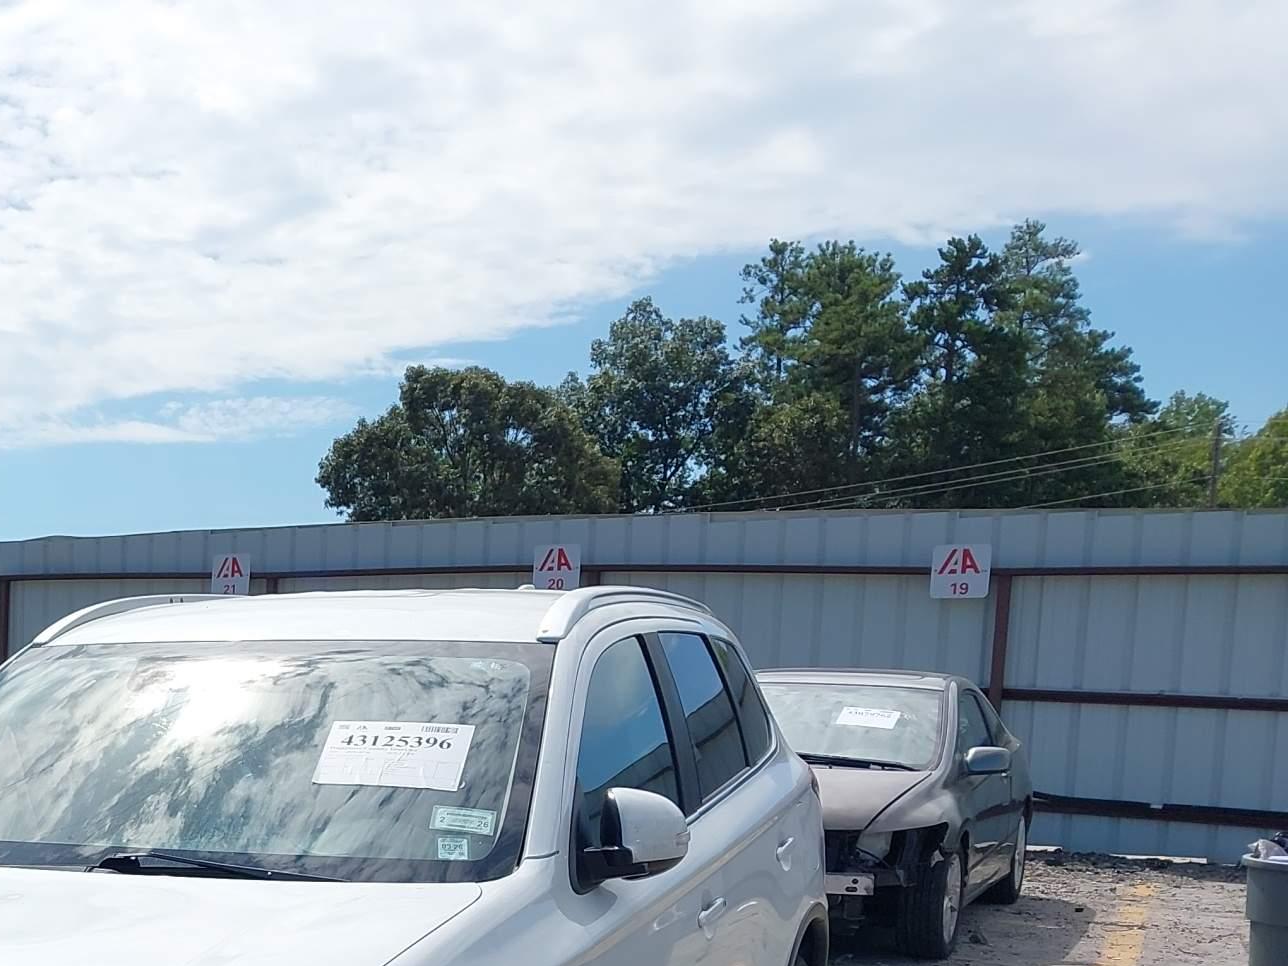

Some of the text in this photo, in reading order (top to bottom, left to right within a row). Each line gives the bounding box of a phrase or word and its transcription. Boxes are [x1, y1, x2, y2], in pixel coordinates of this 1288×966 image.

[223, 584, 237, 594] 21
[547, 578, 564, 590] 20
[949, 582, 970, 595] 19
[340, 733, 454, 750] 43125396
